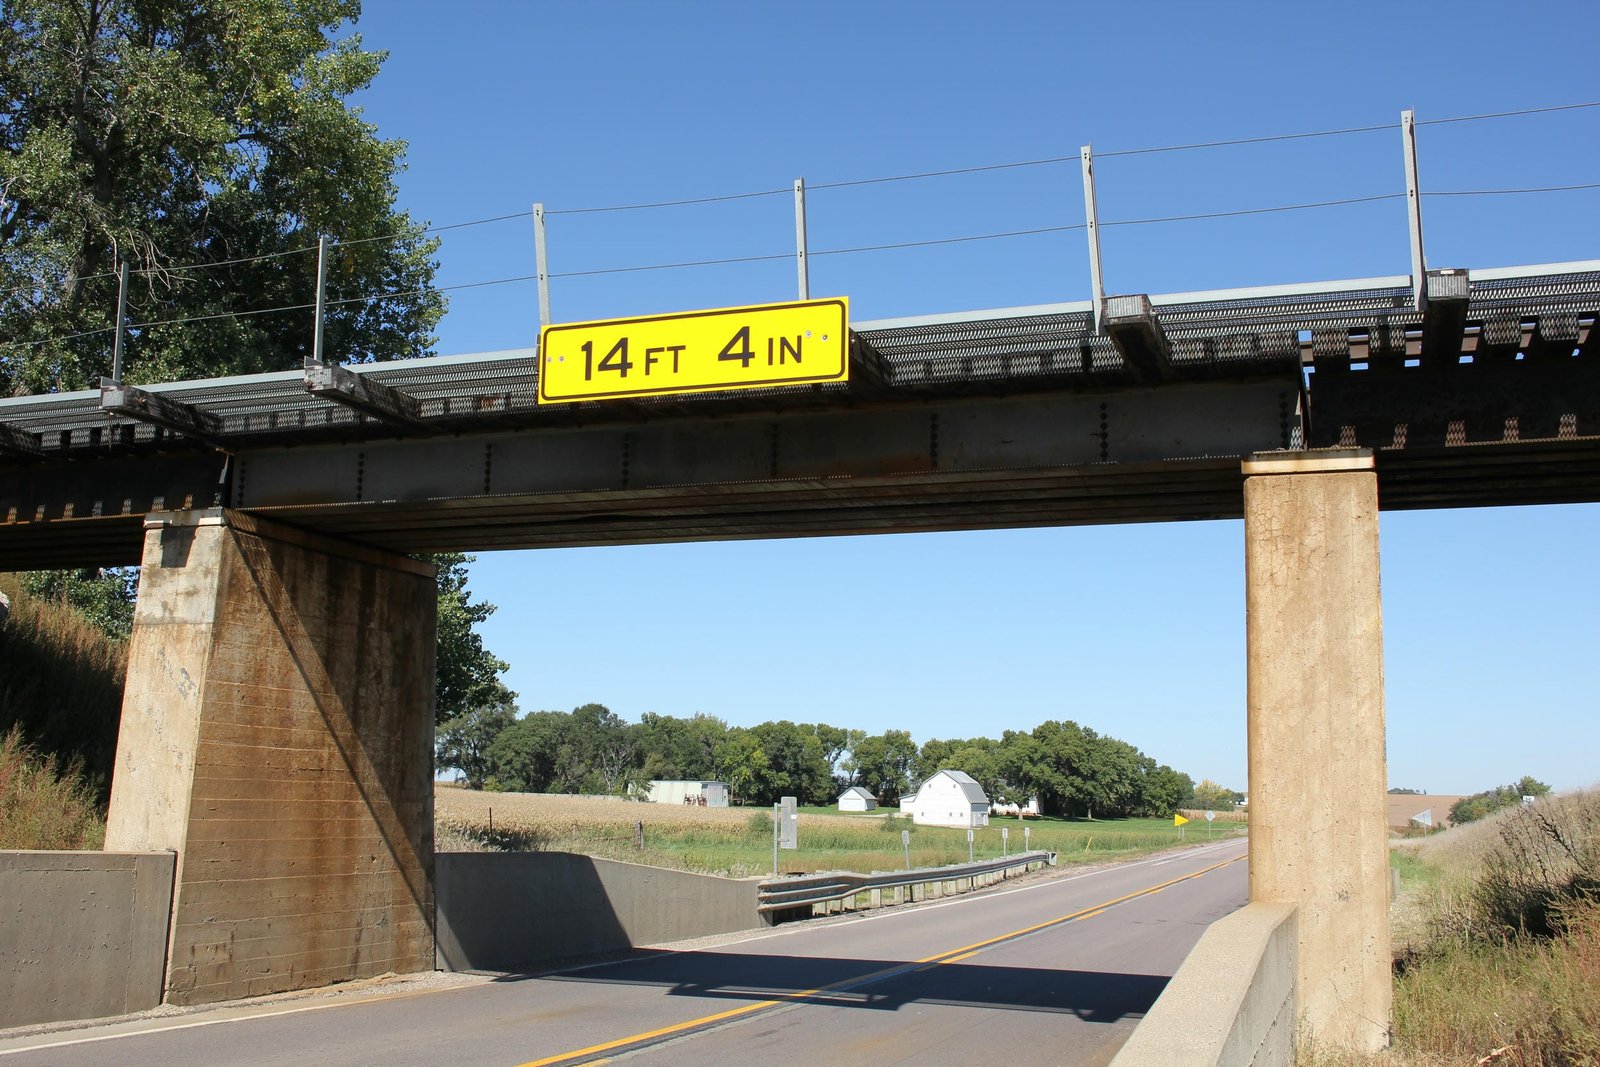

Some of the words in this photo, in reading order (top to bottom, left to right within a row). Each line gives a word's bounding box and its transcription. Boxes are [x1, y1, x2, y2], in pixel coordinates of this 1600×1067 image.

[581, 337, 633, 381] 14
[645, 345, 686, 376] FT
[717, 326, 756, 368] 4
[767, 335, 802, 366] IN
